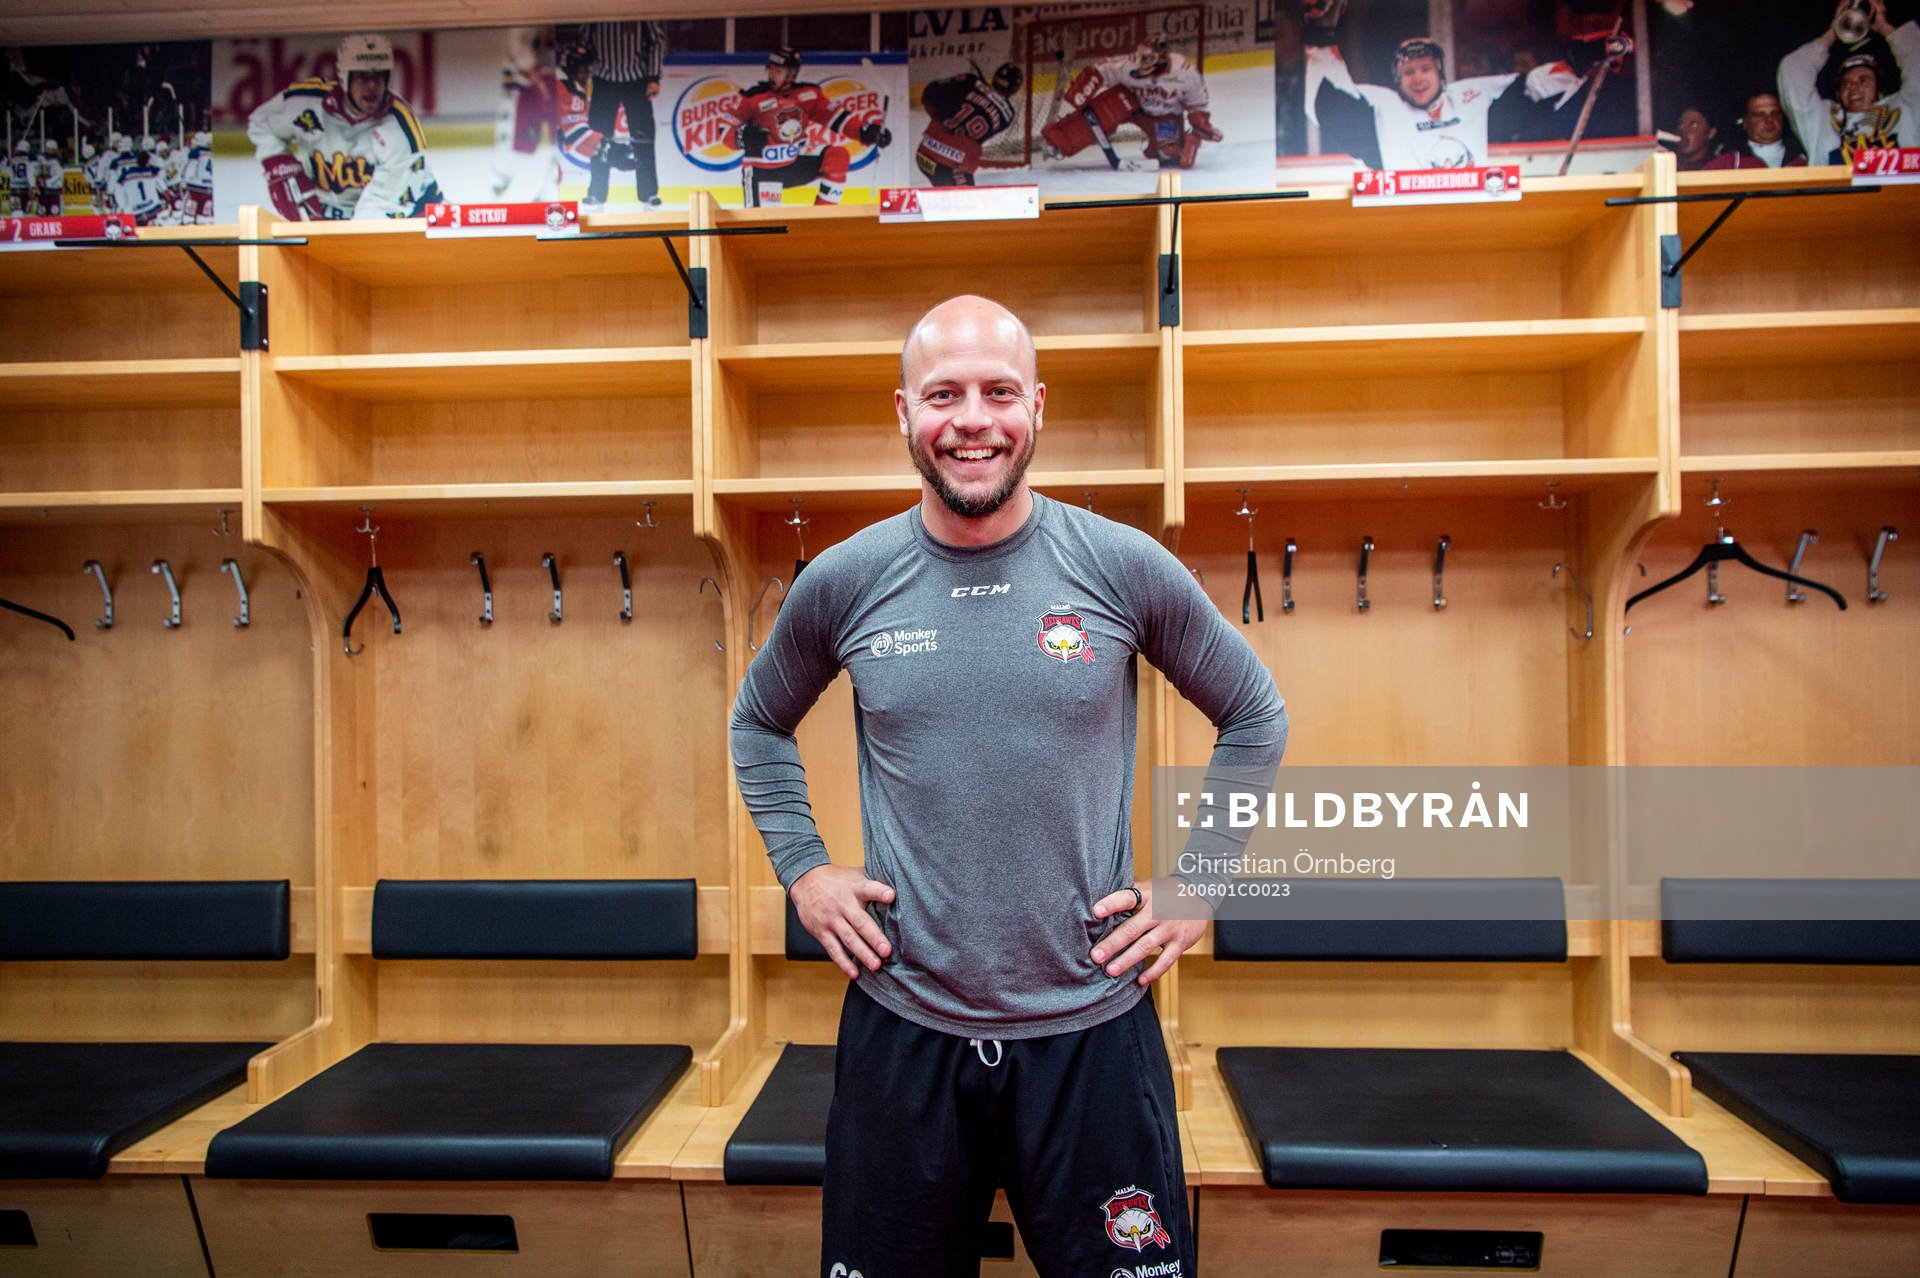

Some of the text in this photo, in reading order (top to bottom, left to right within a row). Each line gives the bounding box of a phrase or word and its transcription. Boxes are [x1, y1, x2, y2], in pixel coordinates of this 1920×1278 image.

[950, 583, 1012, 598] CCM
[894, 628, 938, 642] Monkey
[894, 641, 938, 656] Sports
[1135, 1259, 1180, 1278] Monkey
